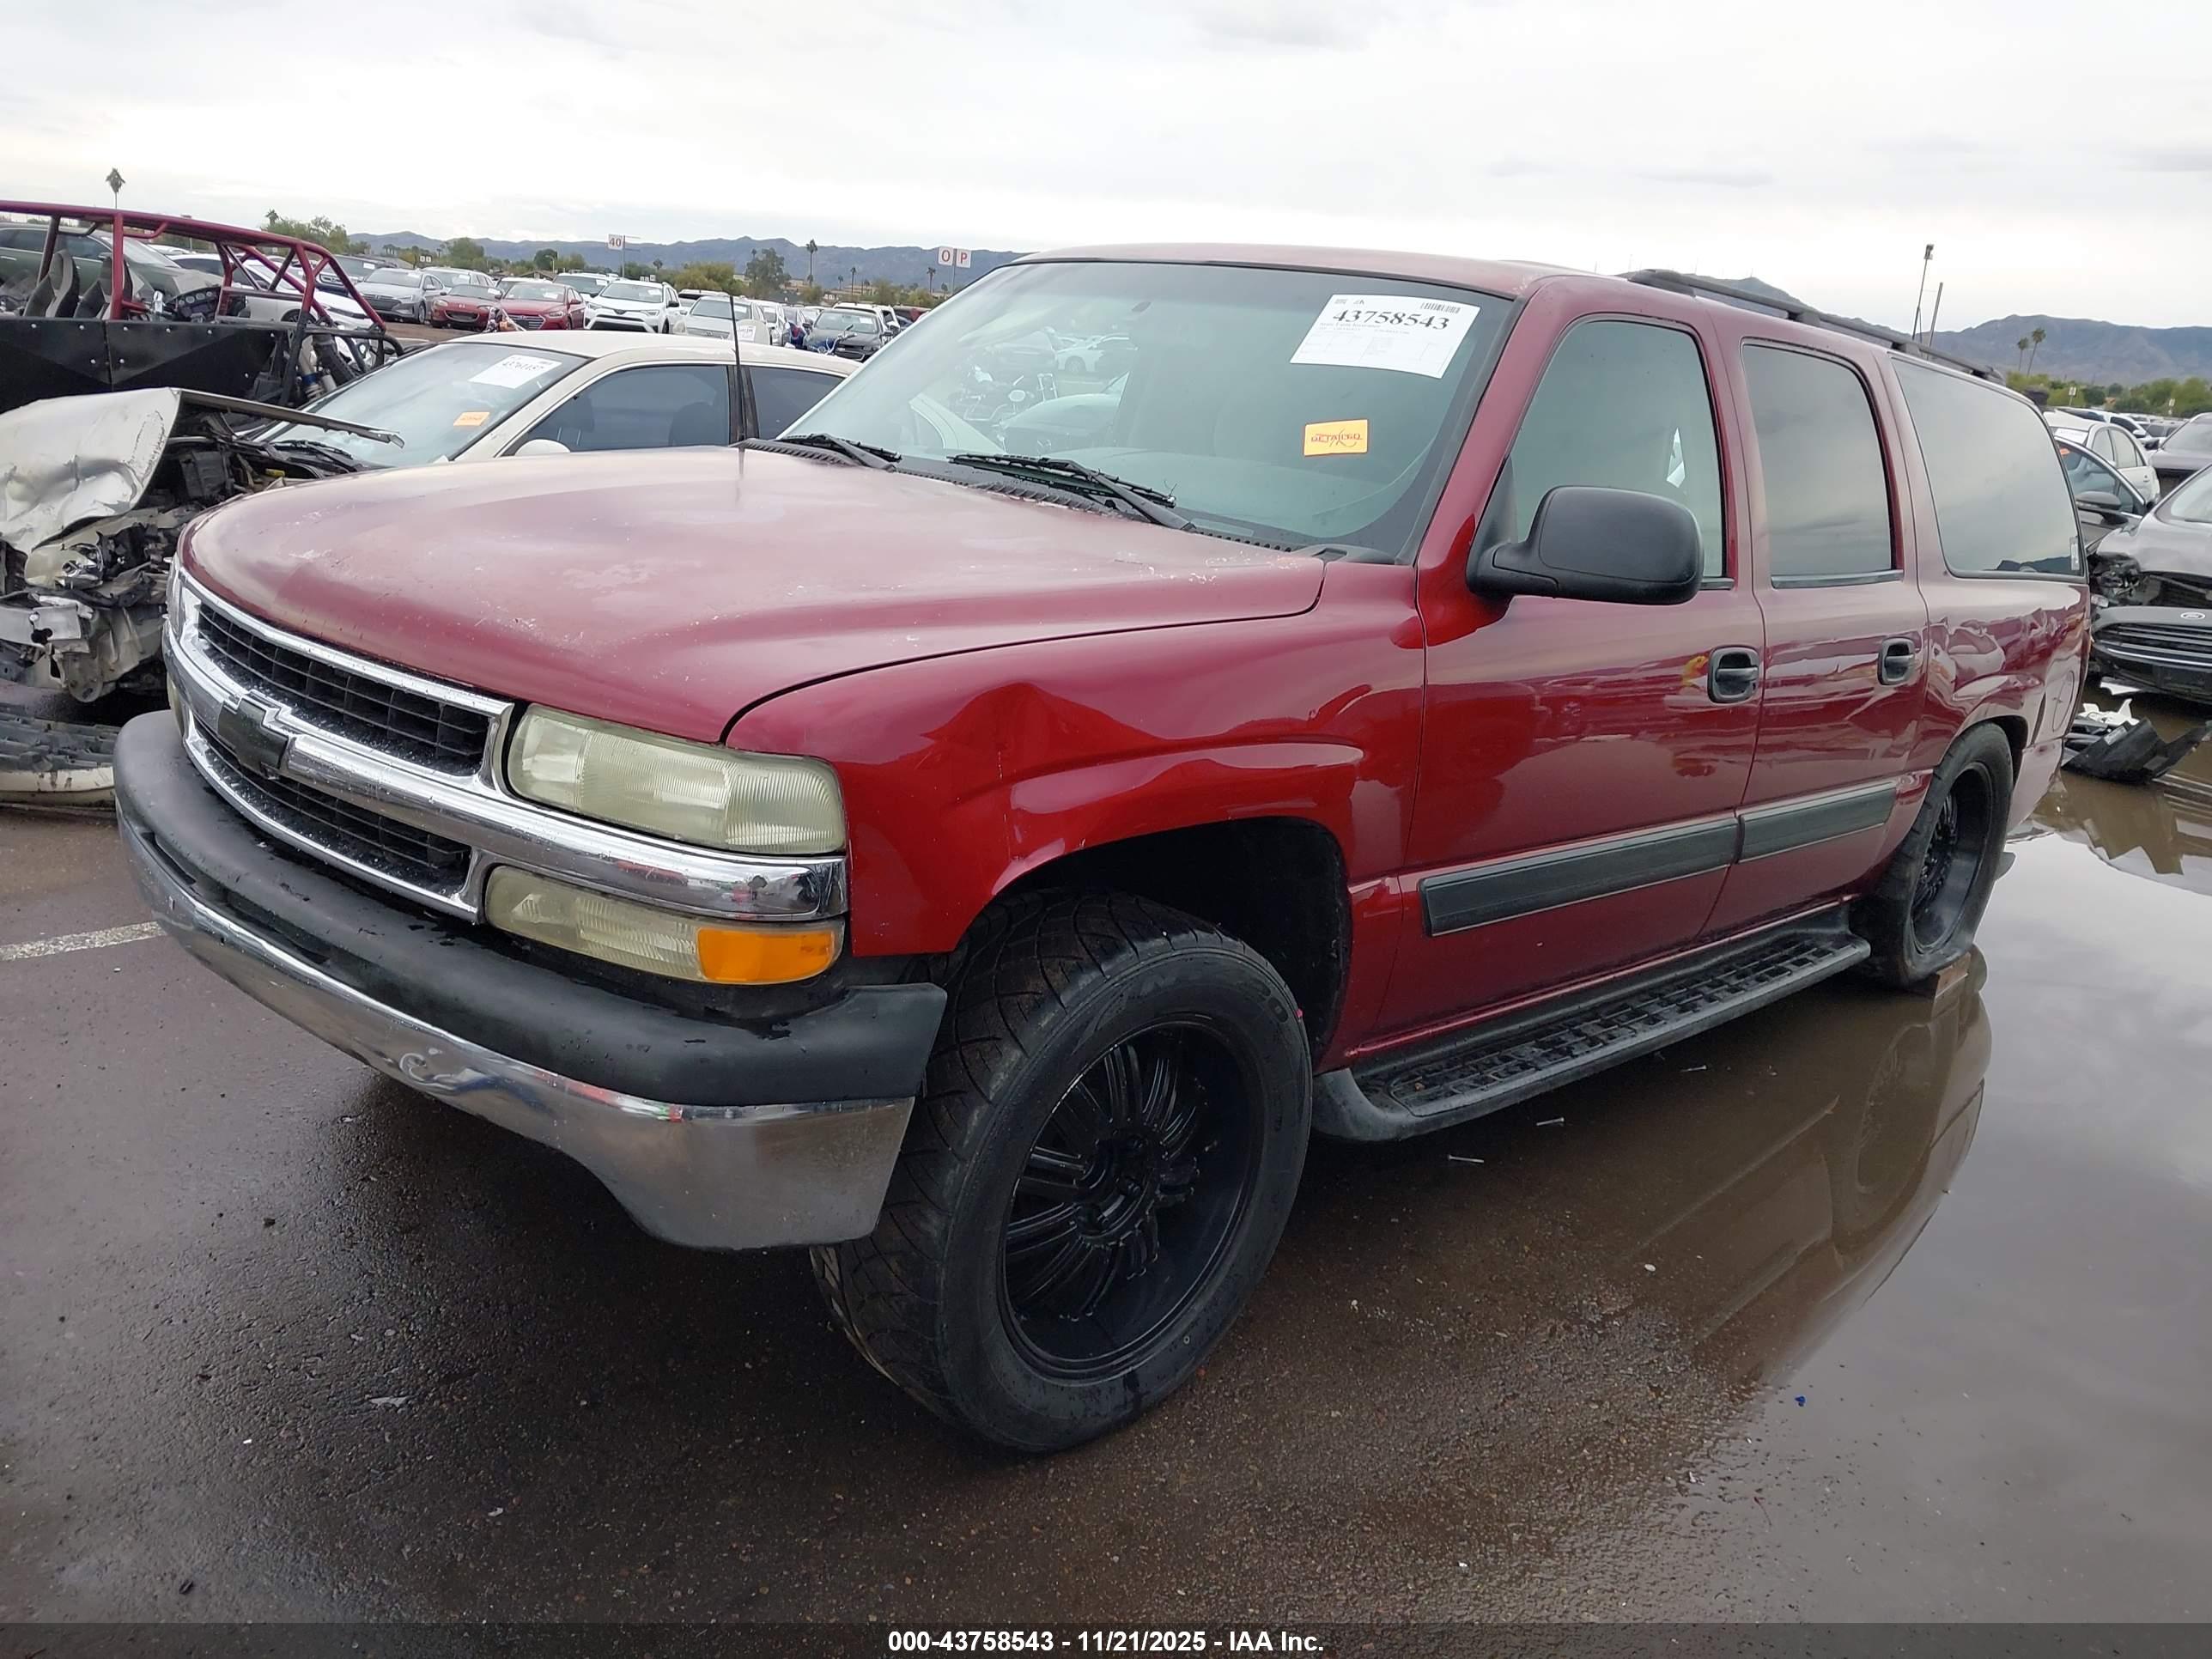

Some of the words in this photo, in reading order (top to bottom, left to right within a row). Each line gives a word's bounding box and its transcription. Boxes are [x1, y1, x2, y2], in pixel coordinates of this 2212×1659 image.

[609, 237, 622, 247] 40
[960, 252, 968, 264] P
[1333, 309, 1449, 330] 43758543
